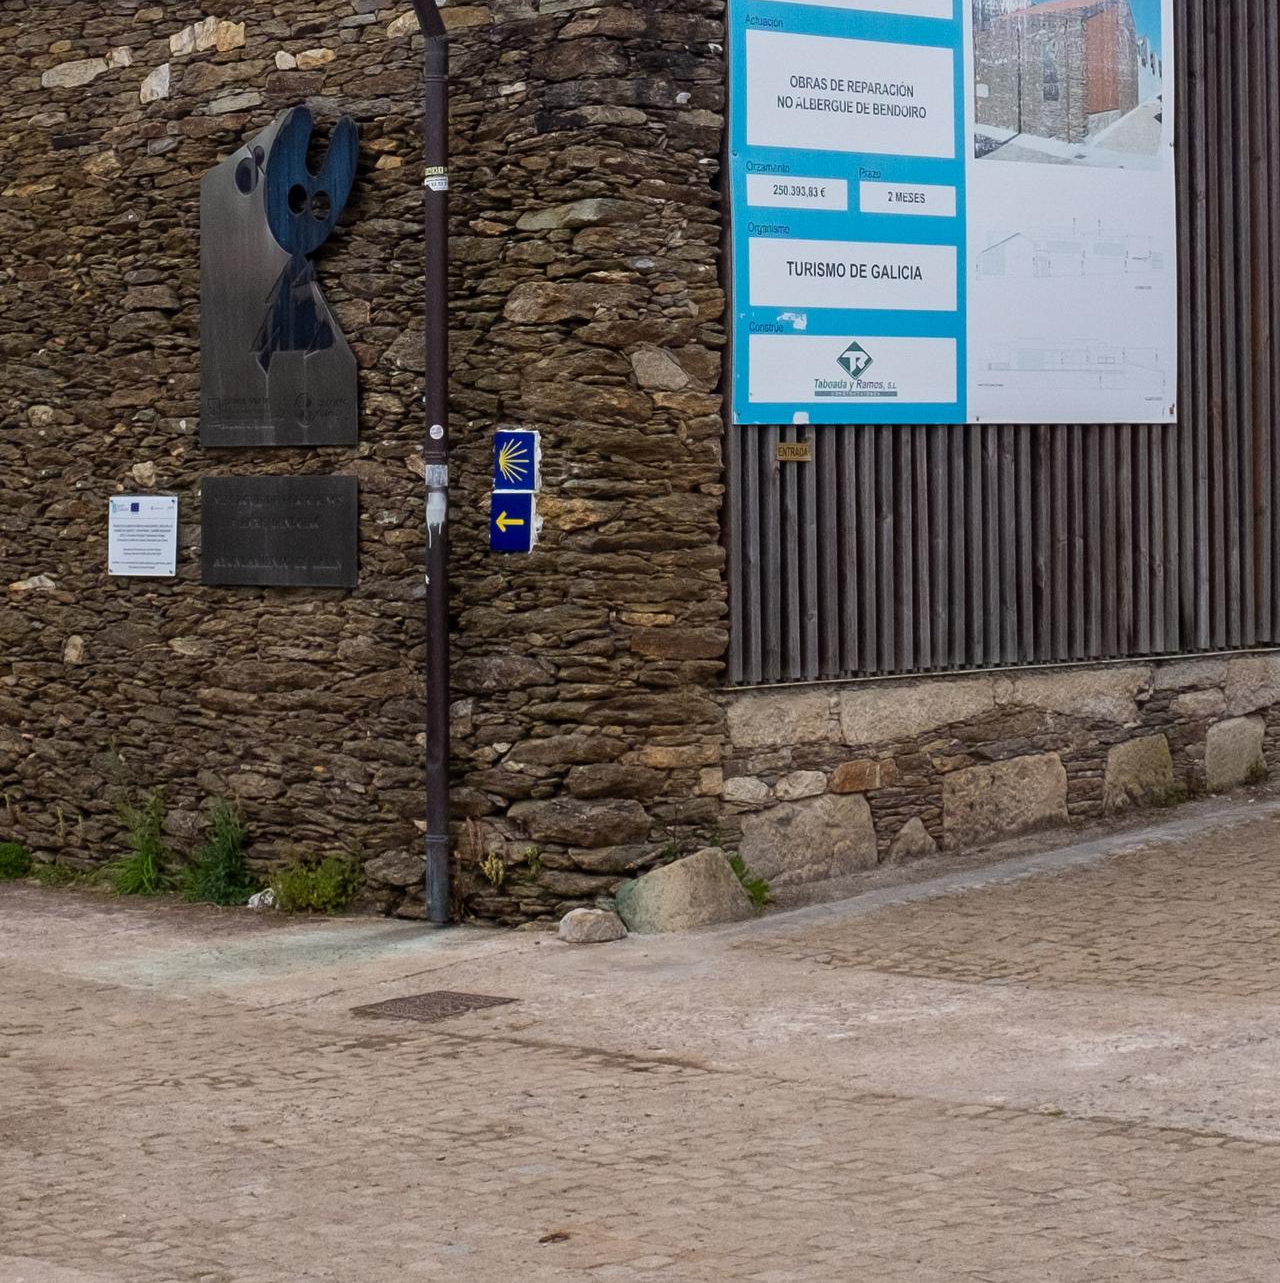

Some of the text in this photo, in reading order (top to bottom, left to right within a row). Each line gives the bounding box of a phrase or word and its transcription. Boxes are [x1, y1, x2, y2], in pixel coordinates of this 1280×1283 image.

[789, 75, 914, 98] OBRAS DE REPARACIÓN
[777, 95, 927, 119] NO ALBERGUE DE BENDOIRO
[820, 187, 826, 198] €
[887, 191, 926, 204] 2 MESES
[787, 261, 923, 281] TURISMO DE GALICIA
[814, 378, 848, 390] Taboada
[849, 381, 856, 392] y
[778, 446, 808, 457] ENTRADA
